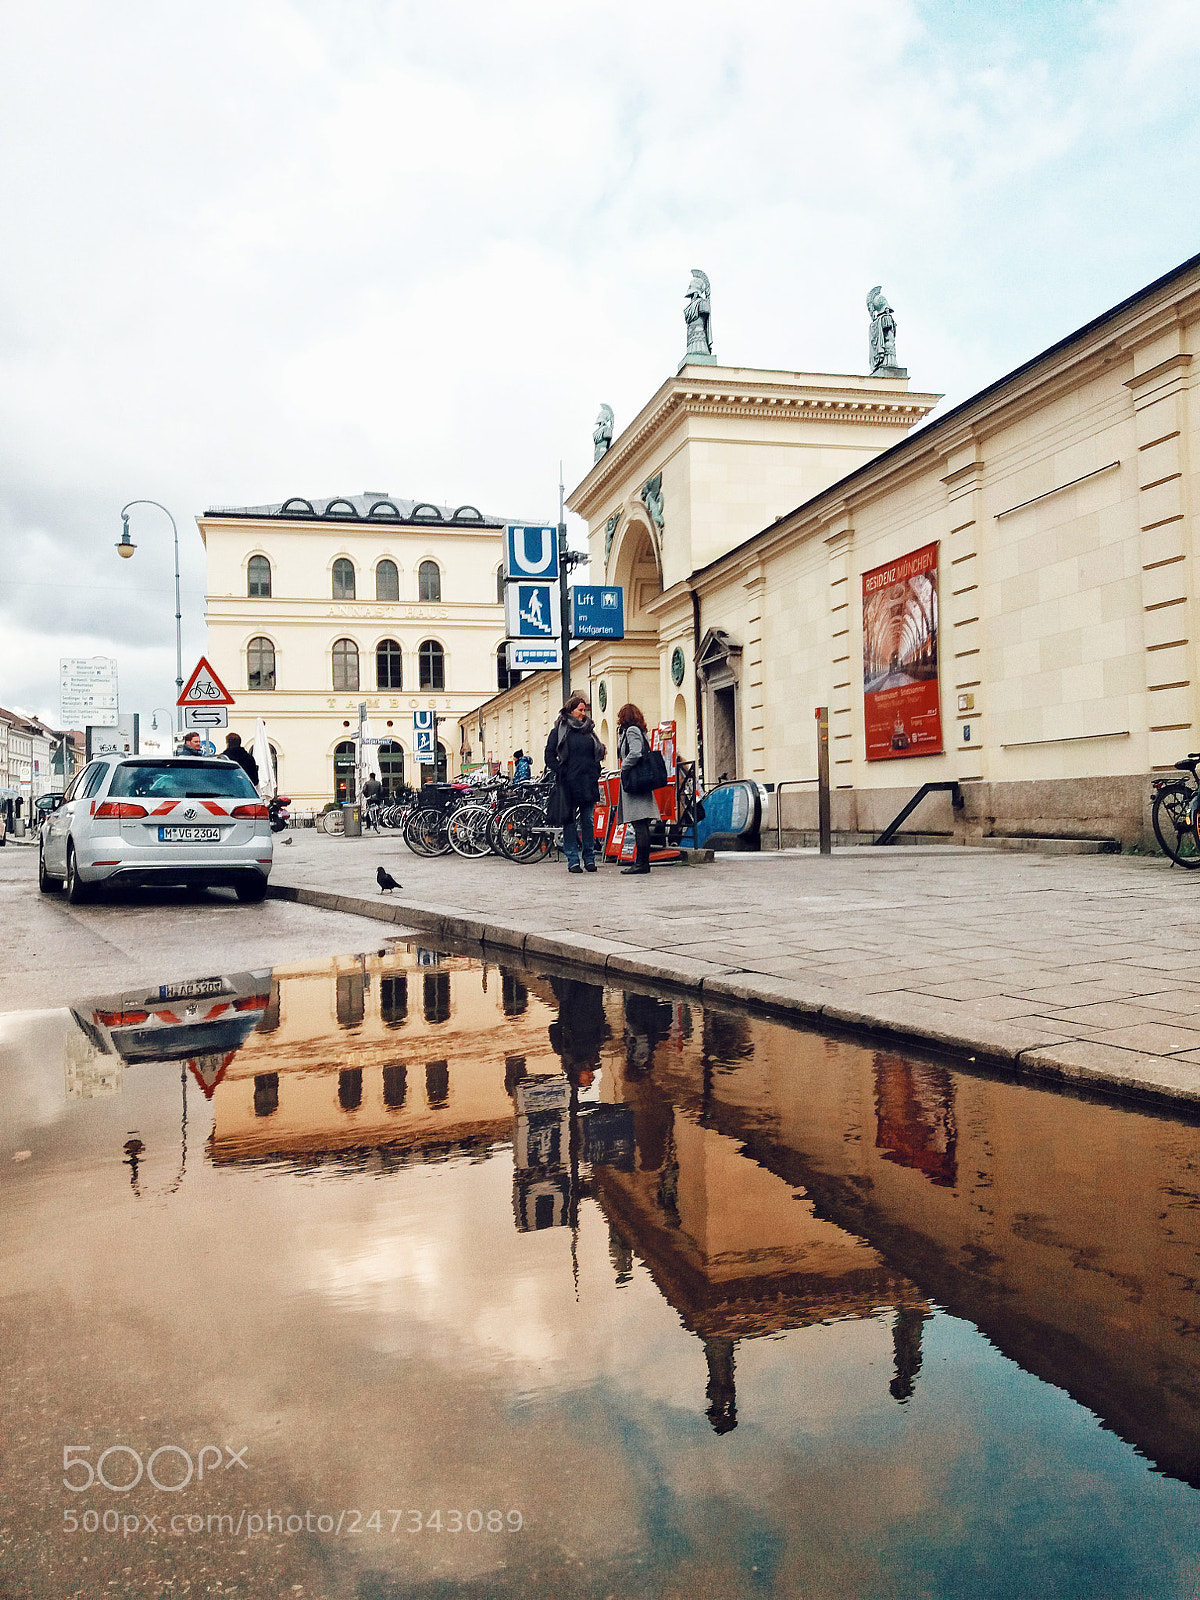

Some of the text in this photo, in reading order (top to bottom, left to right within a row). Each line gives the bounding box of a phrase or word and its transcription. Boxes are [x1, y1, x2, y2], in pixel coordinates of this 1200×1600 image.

[513, 528, 552, 574] U
[865, 551, 933, 592] RESIDENZ MÜNCHEN
[577, 594, 595, 606] Lift
[326, 606, 449, 619] ANNAST HAUS
[578, 625, 614, 635] Hofgarten
[326, 698, 452, 709] TAMBOSI
[415, 711, 431, 729] U
[179, 828, 192, 839] VG
[194, 828, 219, 839] 2304
